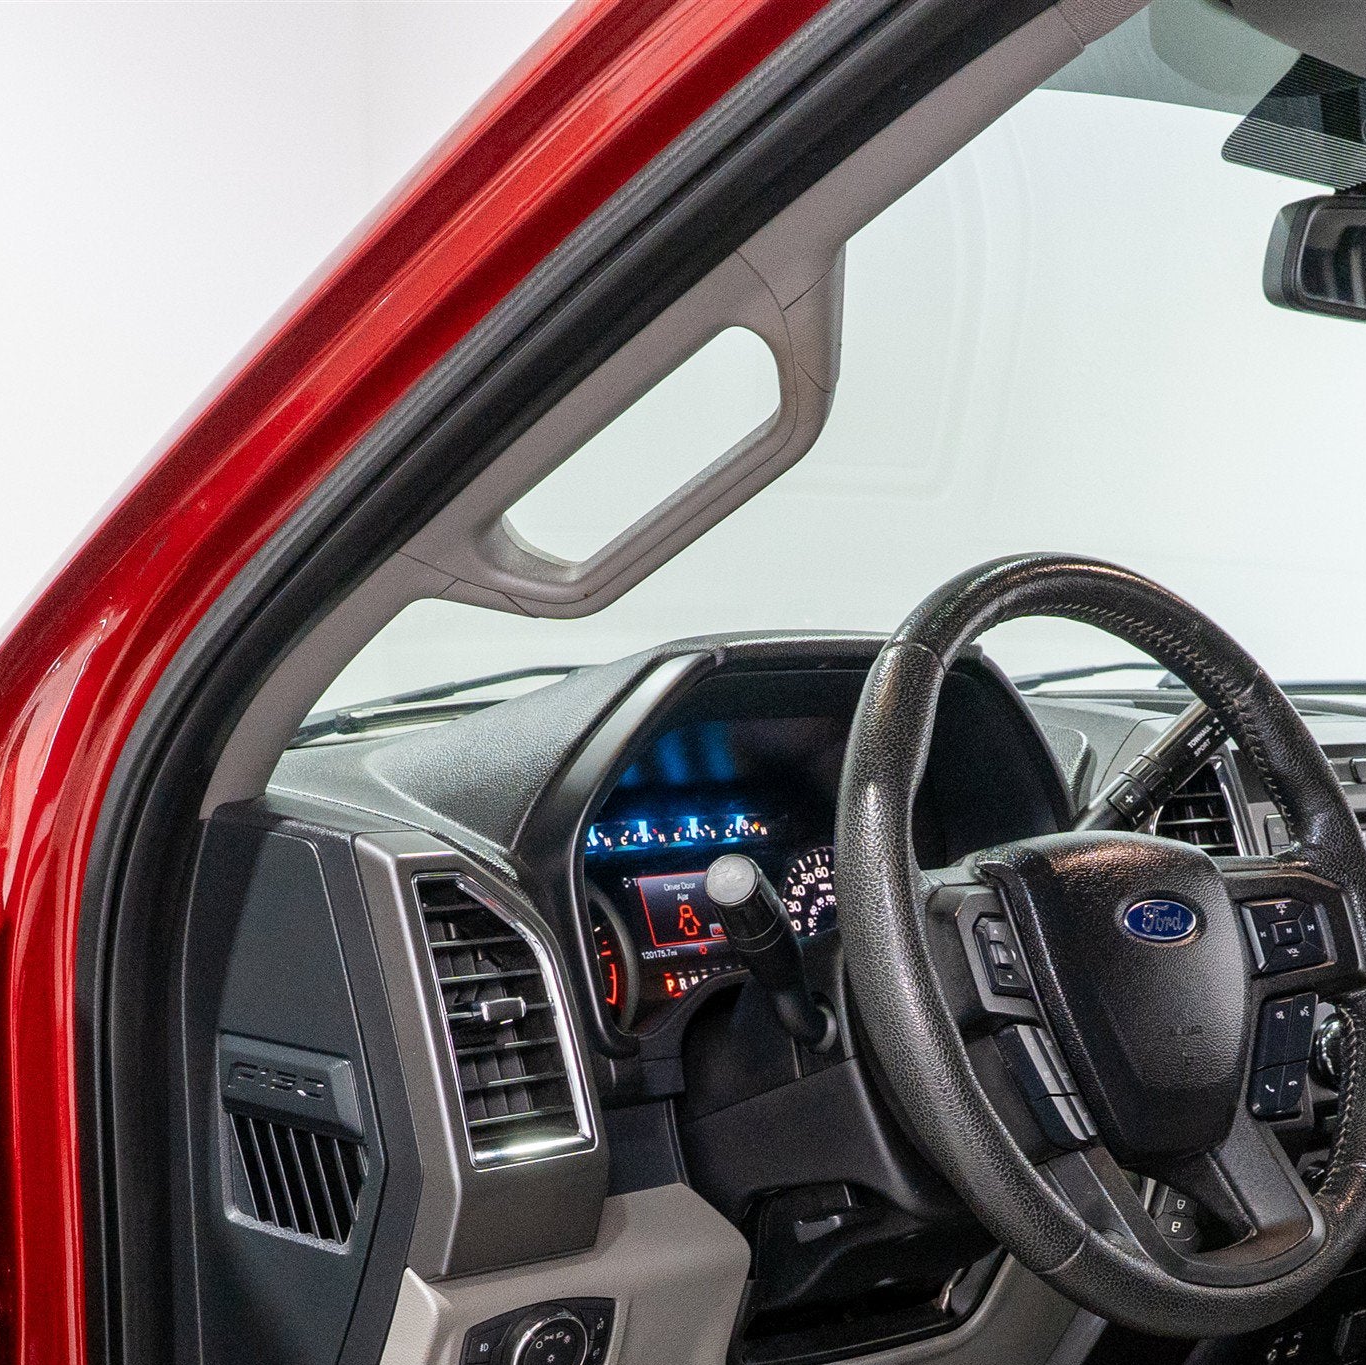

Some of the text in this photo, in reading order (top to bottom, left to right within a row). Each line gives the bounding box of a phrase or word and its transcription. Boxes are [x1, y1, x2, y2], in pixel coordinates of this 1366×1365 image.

[604, 837, 612, 847] H
[620, 836, 628, 846] C
[658, 833, 666, 843] H
[673, 832, 681, 842] E
[800, 872, 815, 885] 50
[814, 866, 829, 879] 60
[663, 881, 696, 892] Driver Door
[791, 884, 806, 897] 40
[787, 900, 802, 913] 30
[1142, 904, 1184, 933] Ford
